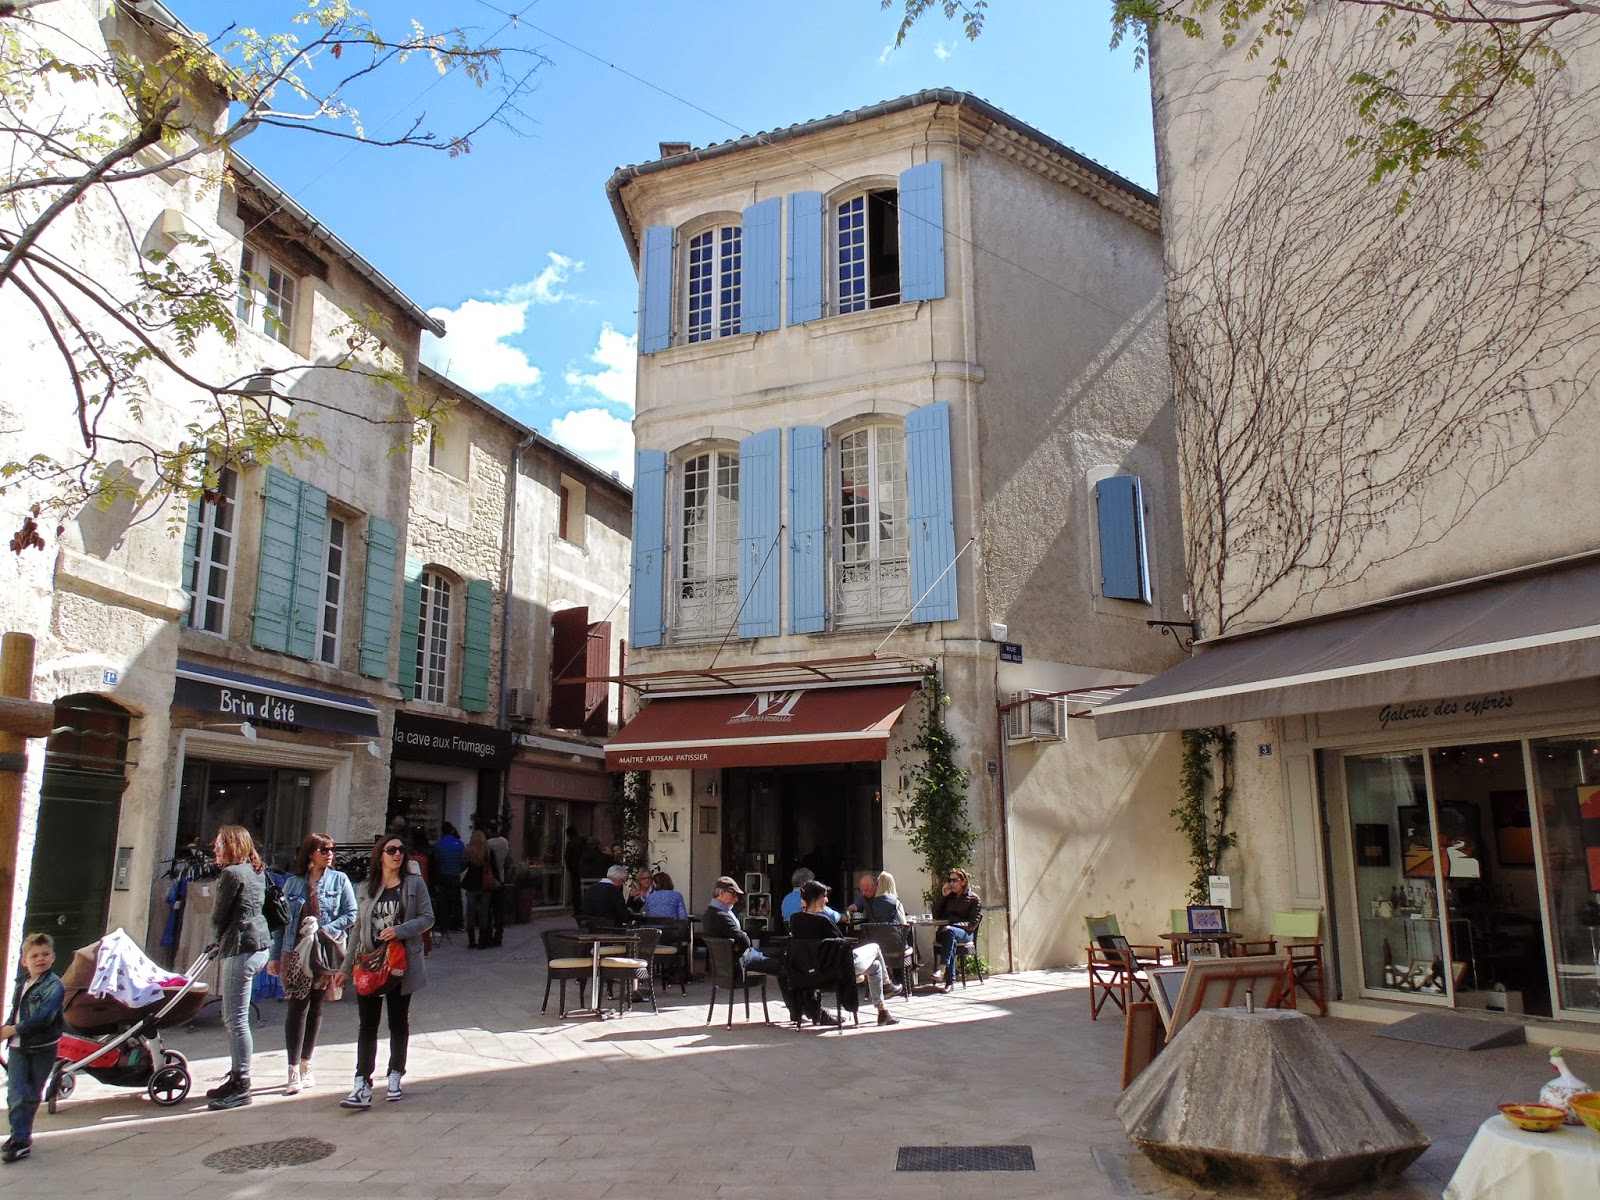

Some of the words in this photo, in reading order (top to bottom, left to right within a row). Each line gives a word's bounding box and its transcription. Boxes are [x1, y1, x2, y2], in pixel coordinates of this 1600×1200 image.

[1006, 645, 1017, 653] RUE
[220, 689, 255, 716] Brin
[260, 695, 295, 722] d'été
[1379, 704, 1429, 729] Galerie
[1434, 699, 1458, 716] des
[1464, 691, 1513, 717] cyprès
[394, 727, 404, 743] la
[406, 732, 431, 746] cave
[432, 735, 451, 749] aux
[452, 736, 496, 757] Fromages
[619, 755, 644, 764] MAÎTRE
[645, 754, 674, 763] ARTISAN
[675, 753, 709, 762] PATISSIER
[657, 811, 680, 833] M
[892, 806, 918, 829] M
[374, 900, 400, 915] VANA
